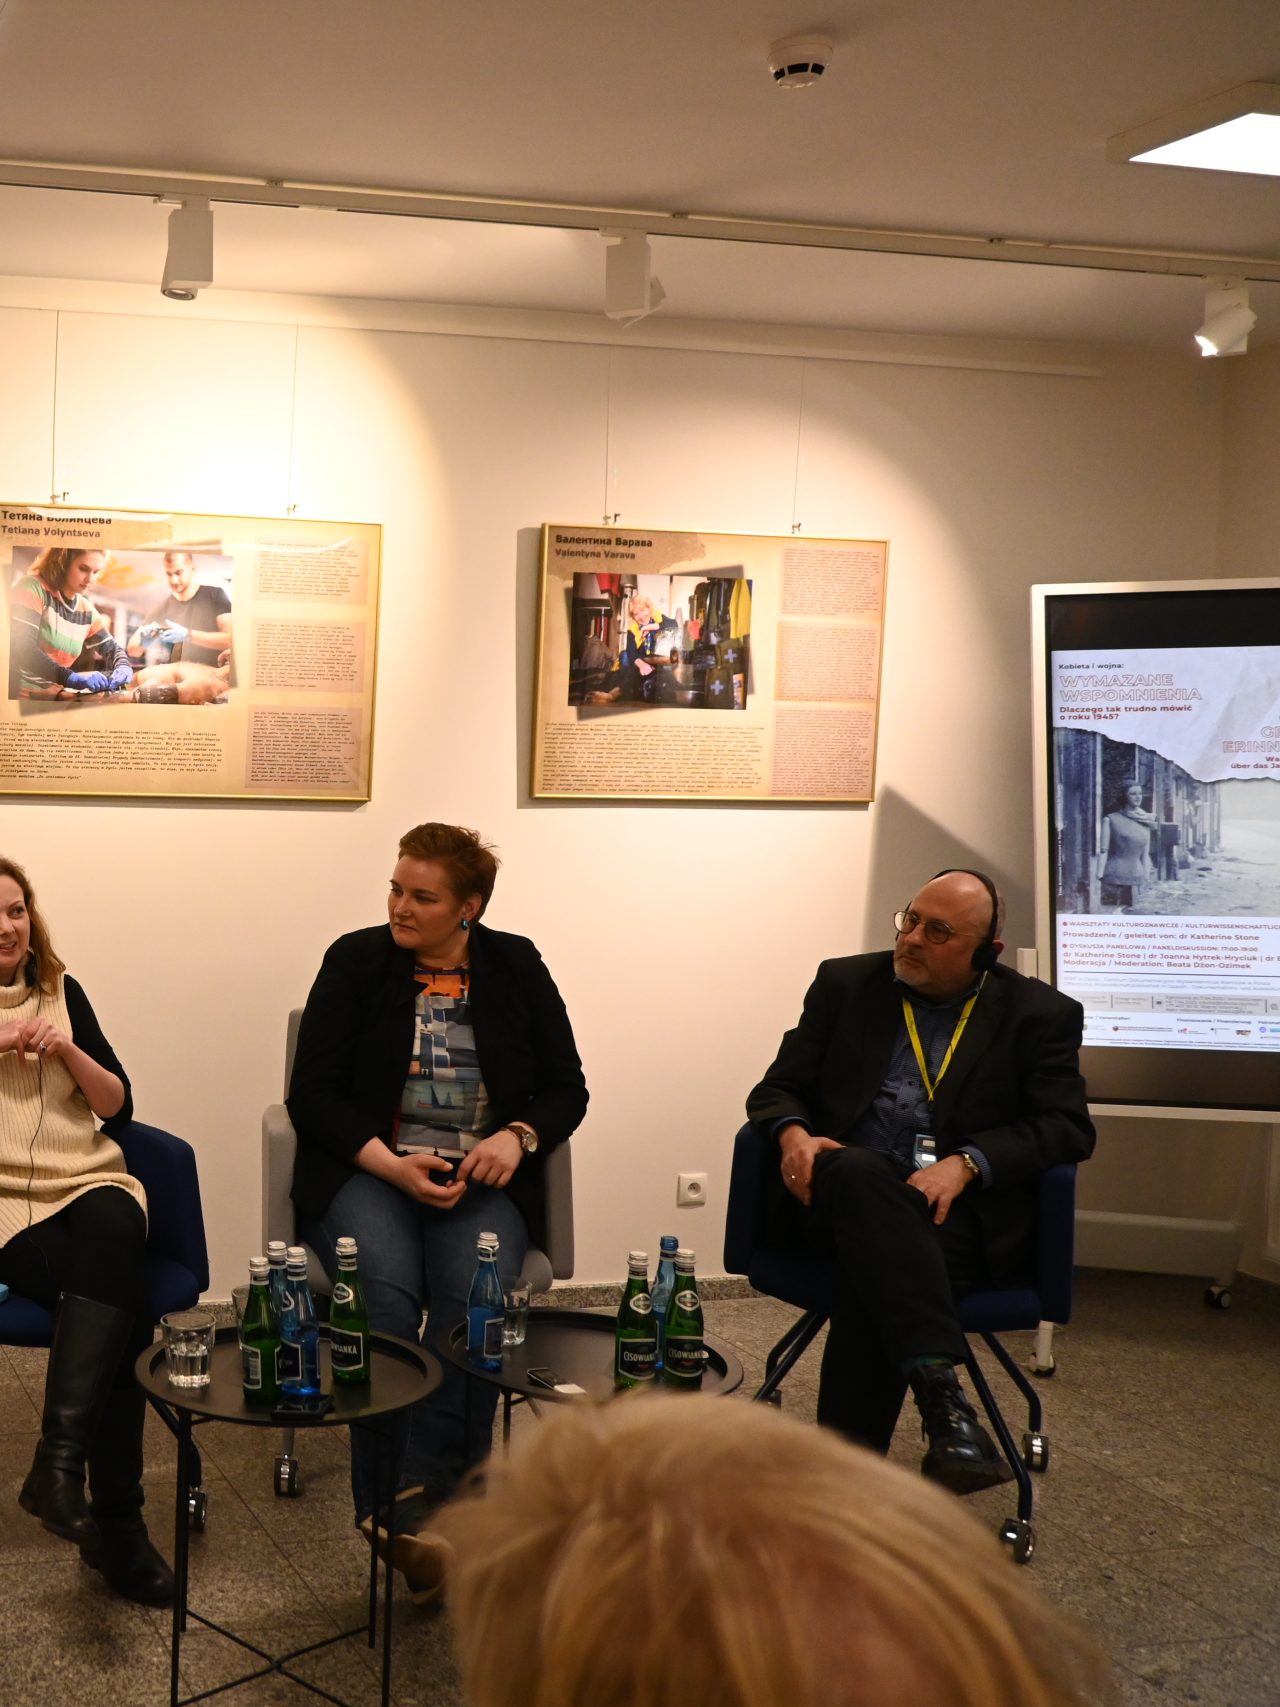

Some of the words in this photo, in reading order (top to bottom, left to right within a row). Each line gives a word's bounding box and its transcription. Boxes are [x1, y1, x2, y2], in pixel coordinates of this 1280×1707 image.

[1, 510, 43, 521] Тетяна
[1, 525, 40, 536] Tetiana
[555, 534, 612, 546] Валентина
[615, 537, 653, 548] Варава
[555, 548, 601, 559] Valentyna
[604, 550, 636, 560] Varava
[1097, 663, 1124, 671] wojna:
[1059, 673, 1174, 688] WYMAZANE
[1059, 688, 1203, 703] WSPOMNIENIA
[1059, 706, 1104, 715] Dlaczego
[1106, 705, 1121, 713] tak
[1160, 704, 1193, 712] mówić
[1093, 713, 1120, 721] 1945?
[1124, 932, 1156, 940] geleitet
[1064, 959, 1106, 967] Moderacja
